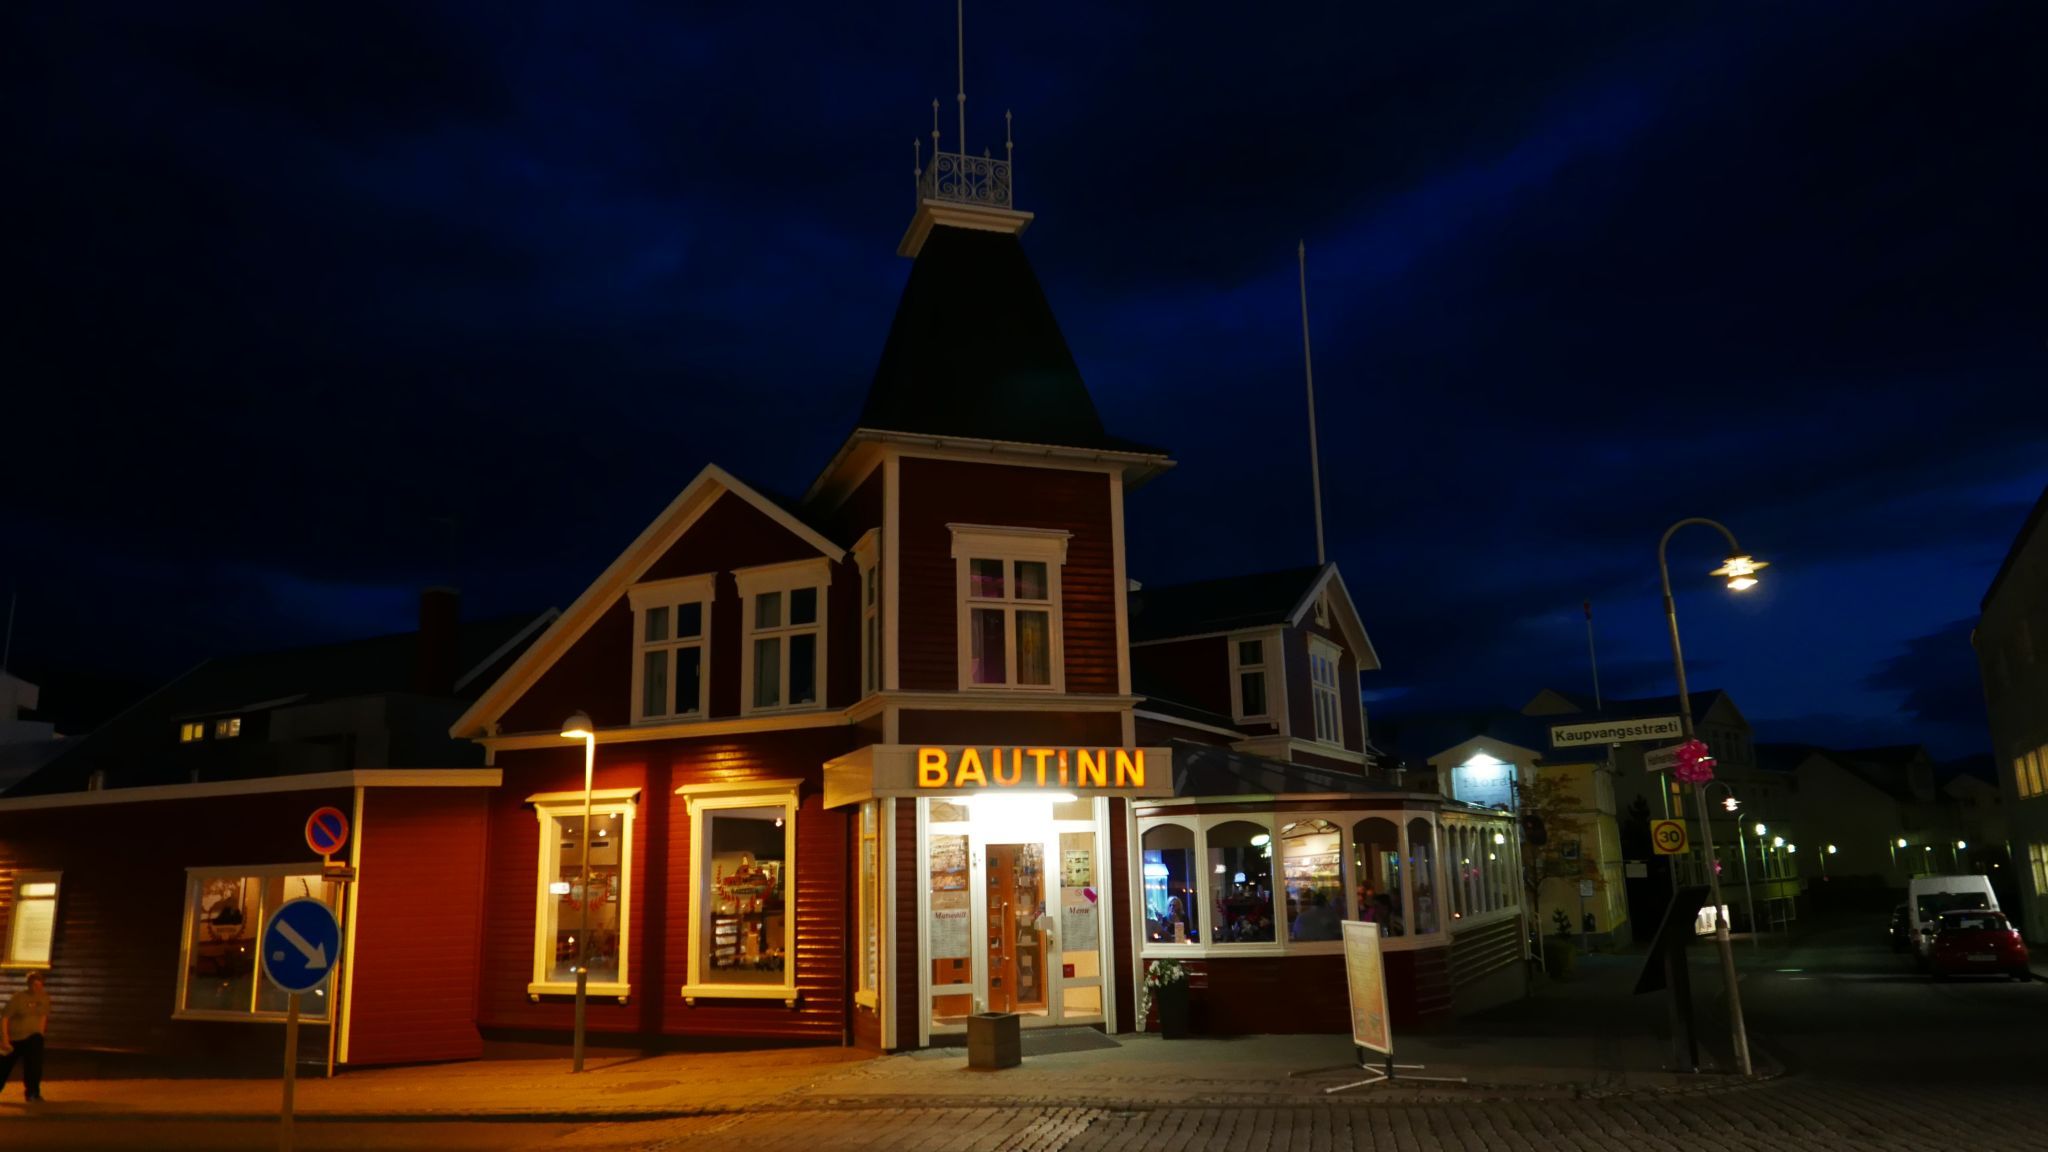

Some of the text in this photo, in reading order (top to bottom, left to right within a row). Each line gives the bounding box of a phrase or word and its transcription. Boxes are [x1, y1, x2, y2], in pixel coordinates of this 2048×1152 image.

[1555, 720, 1678, 742] Kaupvangsstræti
[918, 747, 1145, 788] BAUTINN
[1660, 830, 1680, 843] 30
[1069, 906, 1090, 915] Menu
